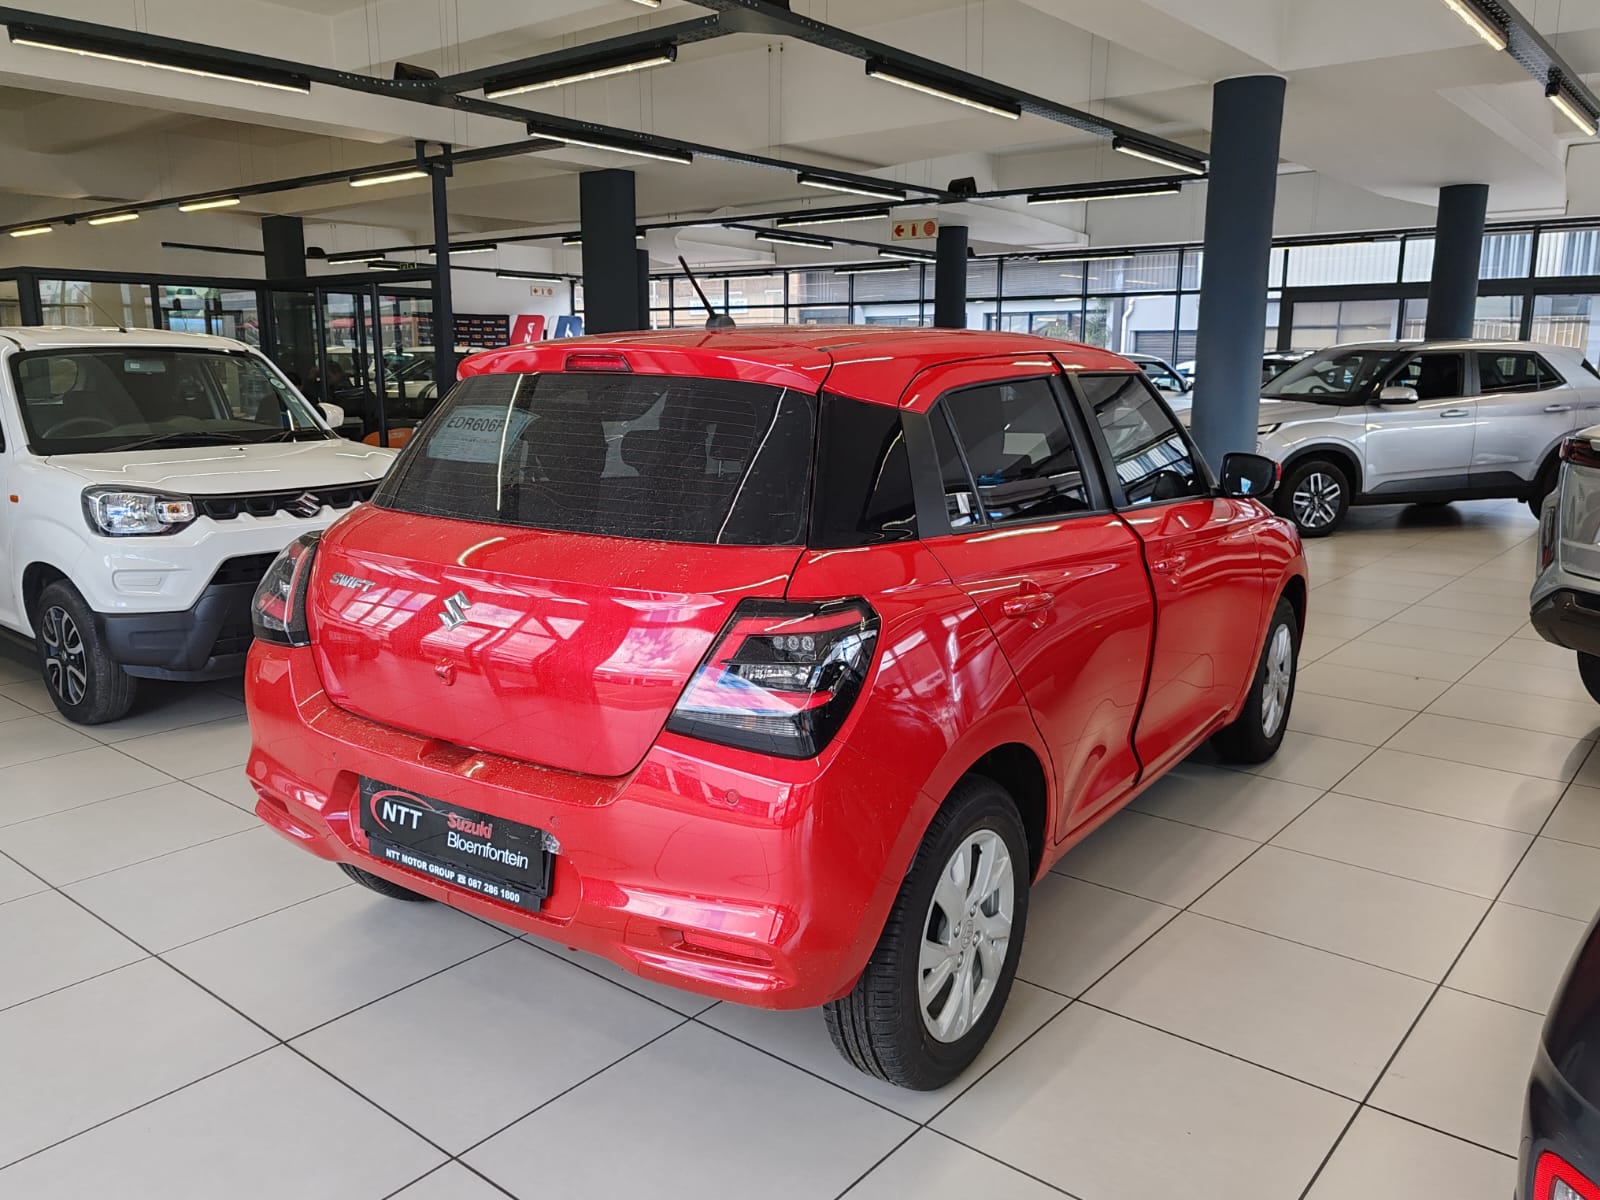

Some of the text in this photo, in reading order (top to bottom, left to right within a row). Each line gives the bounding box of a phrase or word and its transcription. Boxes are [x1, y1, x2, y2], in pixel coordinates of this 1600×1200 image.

[329, 572, 376, 592] SWIFT
[382, 801, 422, 829] NTT
[447, 812, 493, 839] Suzuki
[447, 831, 528, 869] Bloemfontein
[386, 848, 401, 860] NTT
[401, 853, 427, 871] MOTOR
[428, 864, 455, 880] GROUP
[483, 882, 499, 895] 286
